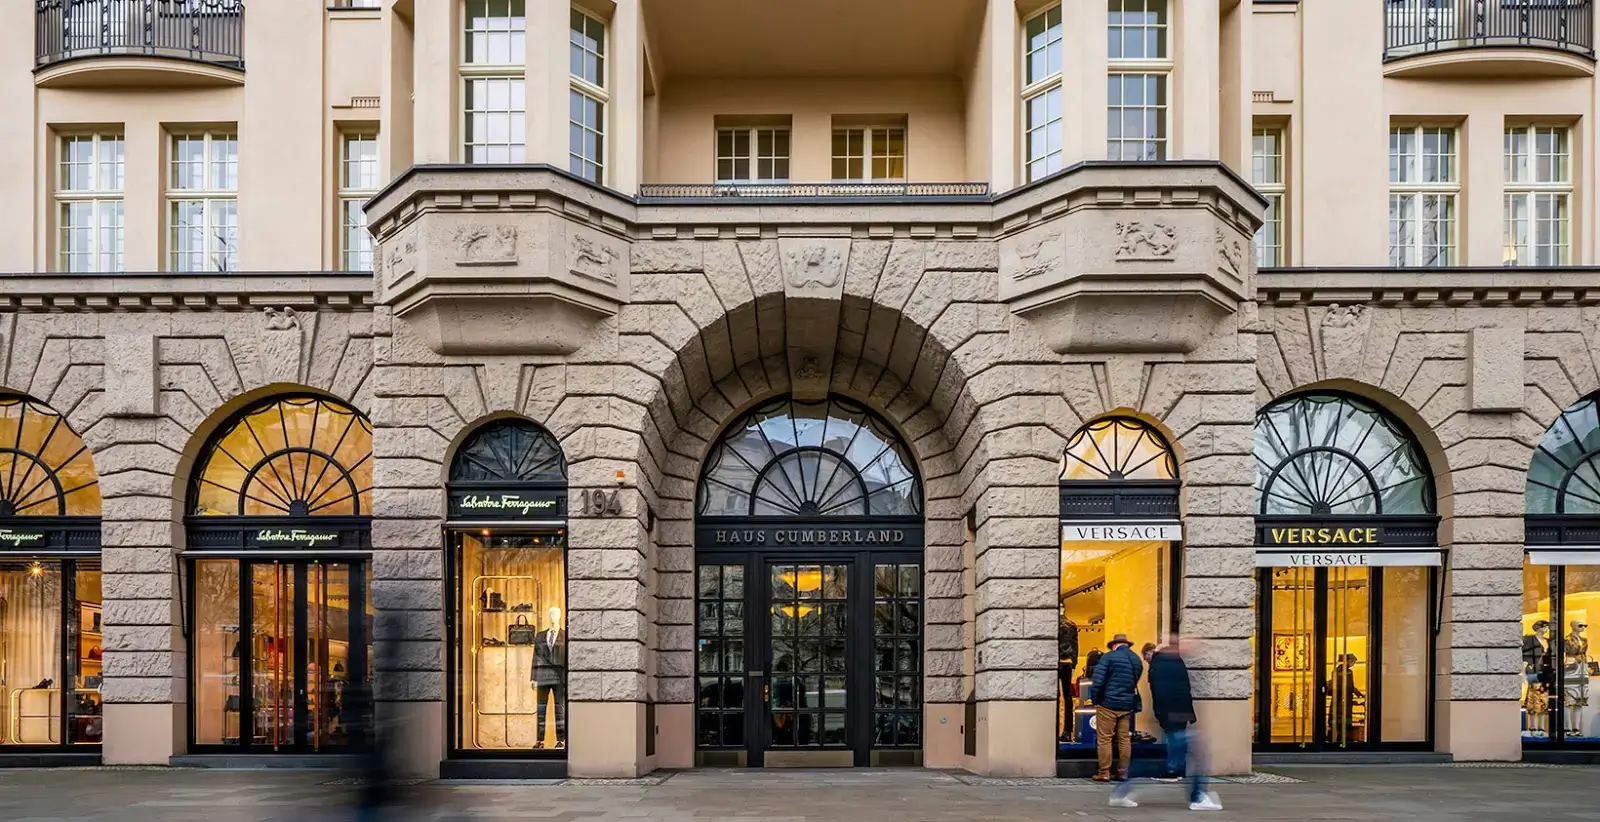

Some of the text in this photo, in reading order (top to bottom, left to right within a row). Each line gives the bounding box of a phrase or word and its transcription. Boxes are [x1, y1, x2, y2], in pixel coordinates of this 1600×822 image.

[460, 495, 556, 515] Salvatore Ferragamo
[581, 489, 622, 514] 194
[256, 529, 338, 546] Salvatore Ferragamo
[716, 530, 905, 543] HAUS CUMBERLAND
[1077, 526, 1169, 539] VERSACE
[1271, 527, 1379, 544] VERSACE
[1290, 554, 1368, 566] VERSACE
